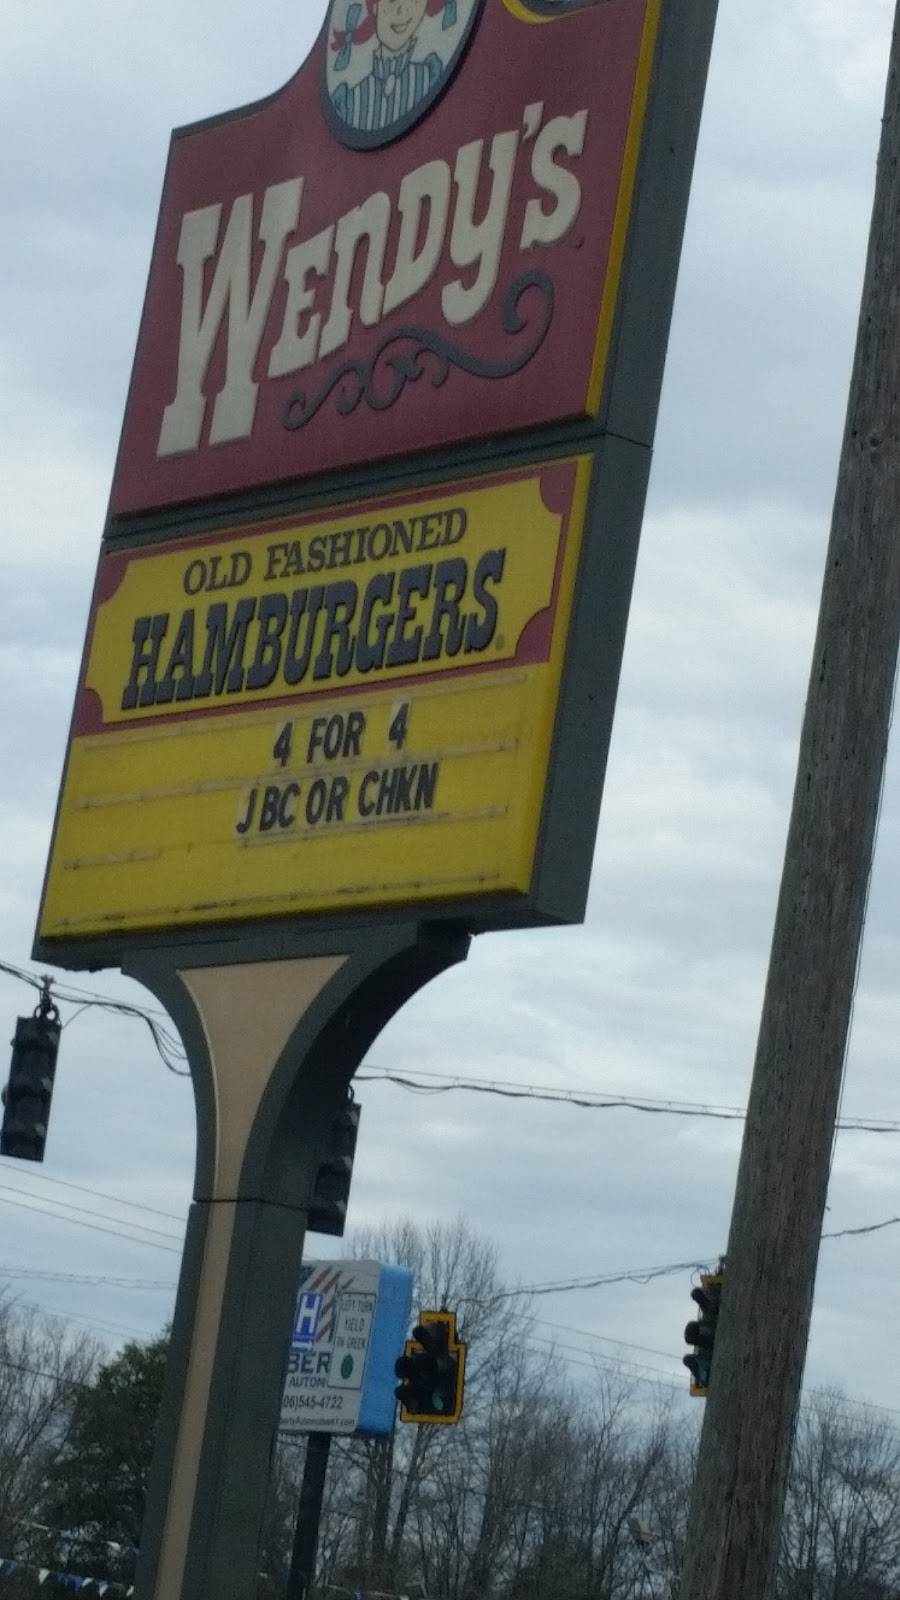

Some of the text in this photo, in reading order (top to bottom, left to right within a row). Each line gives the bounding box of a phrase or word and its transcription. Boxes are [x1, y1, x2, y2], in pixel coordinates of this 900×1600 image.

[157, 101, 589, 458] Wendy's
[184, 507, 467, 594] OLD FASHIONED
[121, 548, 506, 710] HAMBURGERS
[273, 703, 409, 768] 4 FOR 4
[305, 776, 348, 825] OR
[358, 762, 439, 817] CHKN
[295, 1294, 321, 1333] H
[344, 1317, 365, 1331] YIELD
